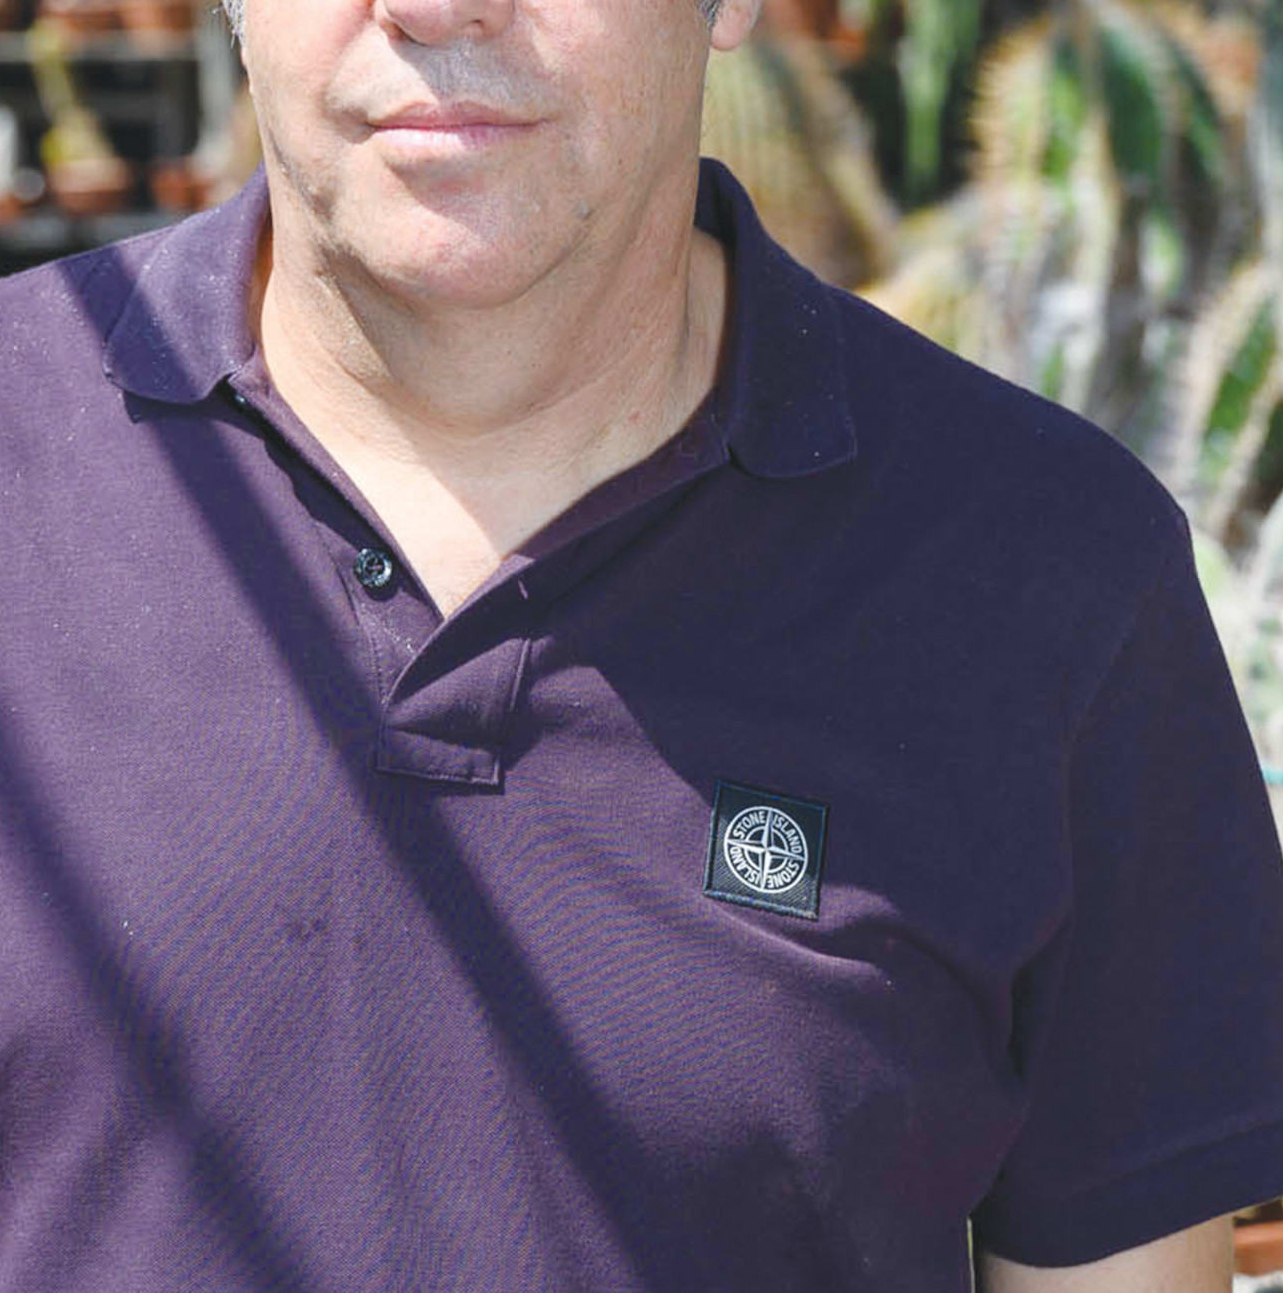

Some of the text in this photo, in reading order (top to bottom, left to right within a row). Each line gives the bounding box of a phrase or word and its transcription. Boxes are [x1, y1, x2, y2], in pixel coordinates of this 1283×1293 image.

[733, 810, 802, 854] STONE ISLAND
[730, 846, 800, 888] STONE ISLAND
